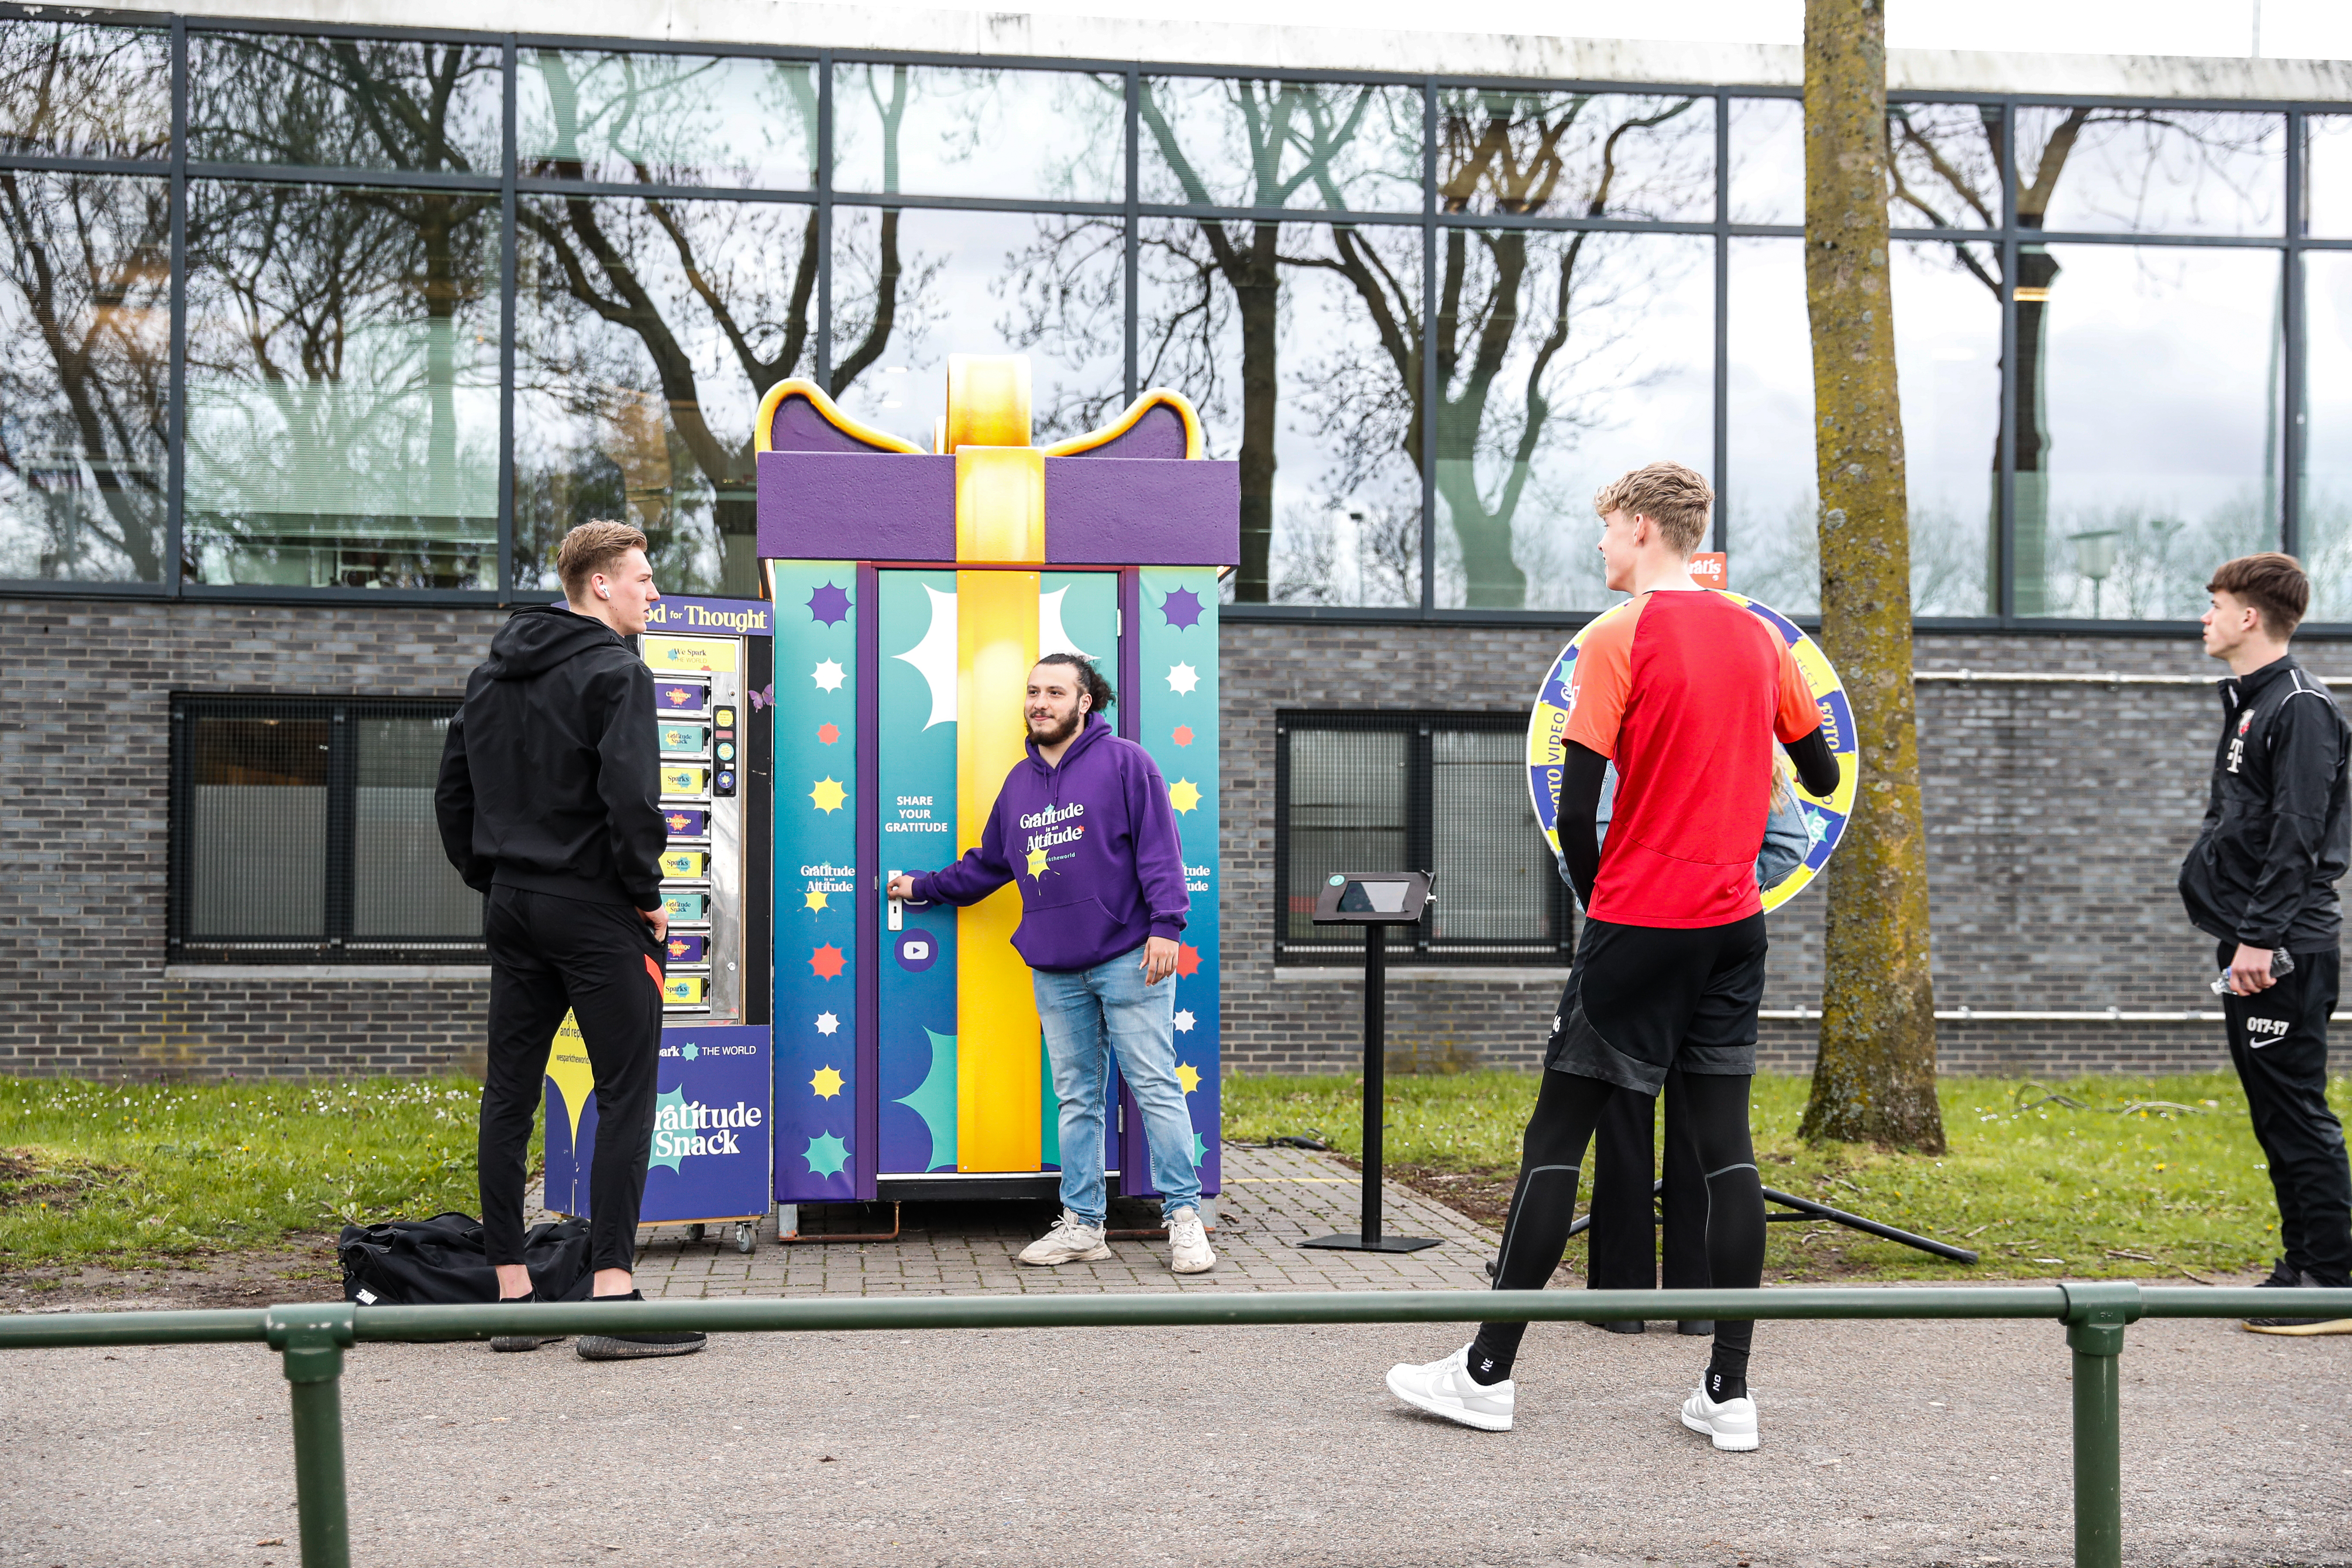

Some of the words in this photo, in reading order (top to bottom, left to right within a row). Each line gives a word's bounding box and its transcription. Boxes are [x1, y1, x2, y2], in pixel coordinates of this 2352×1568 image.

[1689, 558, 1721, 574] ratis
[645, 603, 667, 623] od
[670, 610, 683, 619] for
[684, 605, 768, 633] Thought
[687, 649, 706, 657] Spark
[665, 691, 692, 699] Challenge
[1548, 712, 1565, 762] VIDEO
[897, 796, 933, 805] SHARE
[898, 809, 931, 819] YOUR
[1020, 802, 1084, 829] Gratitude
[885, 822, 948, 832] GRATITUDE
[1026, 826, 1083, 851] Attitude
[800, 864, 856, 876] Gratitude
[1182, 865, 1211, 876] tude
[806, 881, 854, 892] Attitude
[1186, 880, 1209, 891] ude
[560, 1025, 570, 1037] and
[659, 1045, 680, 1057] ark
[702, 1046, 720, 1056] THE
[722, 1045, 756, 1055] WORLD
[653, 1100, 762, 1131] ratitude
[655, 1129, 740, 1157] Snack
[356, 1288, 378, 1305] NIKE
